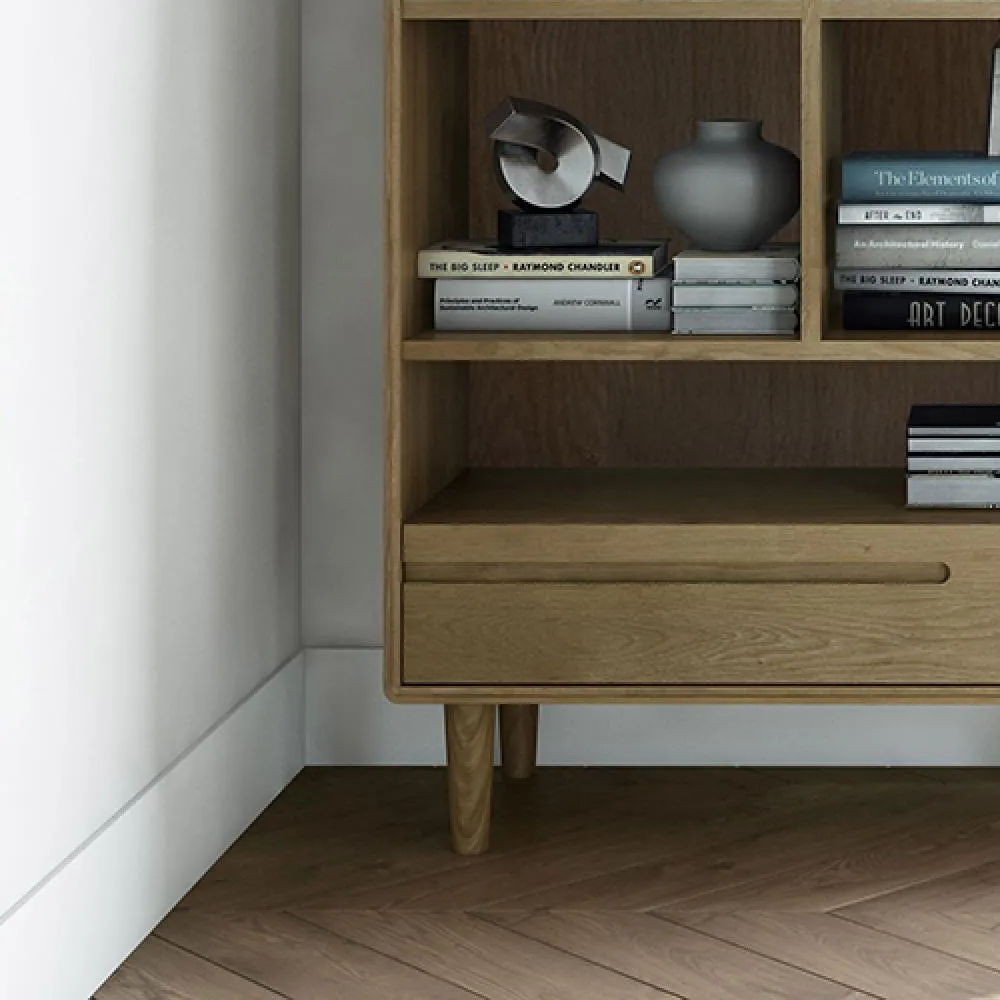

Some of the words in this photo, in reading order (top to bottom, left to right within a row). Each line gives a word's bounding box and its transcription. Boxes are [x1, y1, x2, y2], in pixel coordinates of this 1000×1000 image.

[873, 169, 906, 186] The
[908, 169, 982, 186] Elements
[982, 169, 1000, 186] of
[429, 262, 447, 271] THE
[451, 262, 469, 271] BIG
[472, 262, 500, 271] SLEEP
[512, 262, 565, 271] RAYMOND
[567, 262, 621, 271] CHANDLER
[839, 274, 857, 284] THE
[859, 275, 877, 284] BIG
[880, 275, 907, 285] SLEEP
[919, 277, 969, 287] RAYMOND
[906, 301, 947, 327] ART
